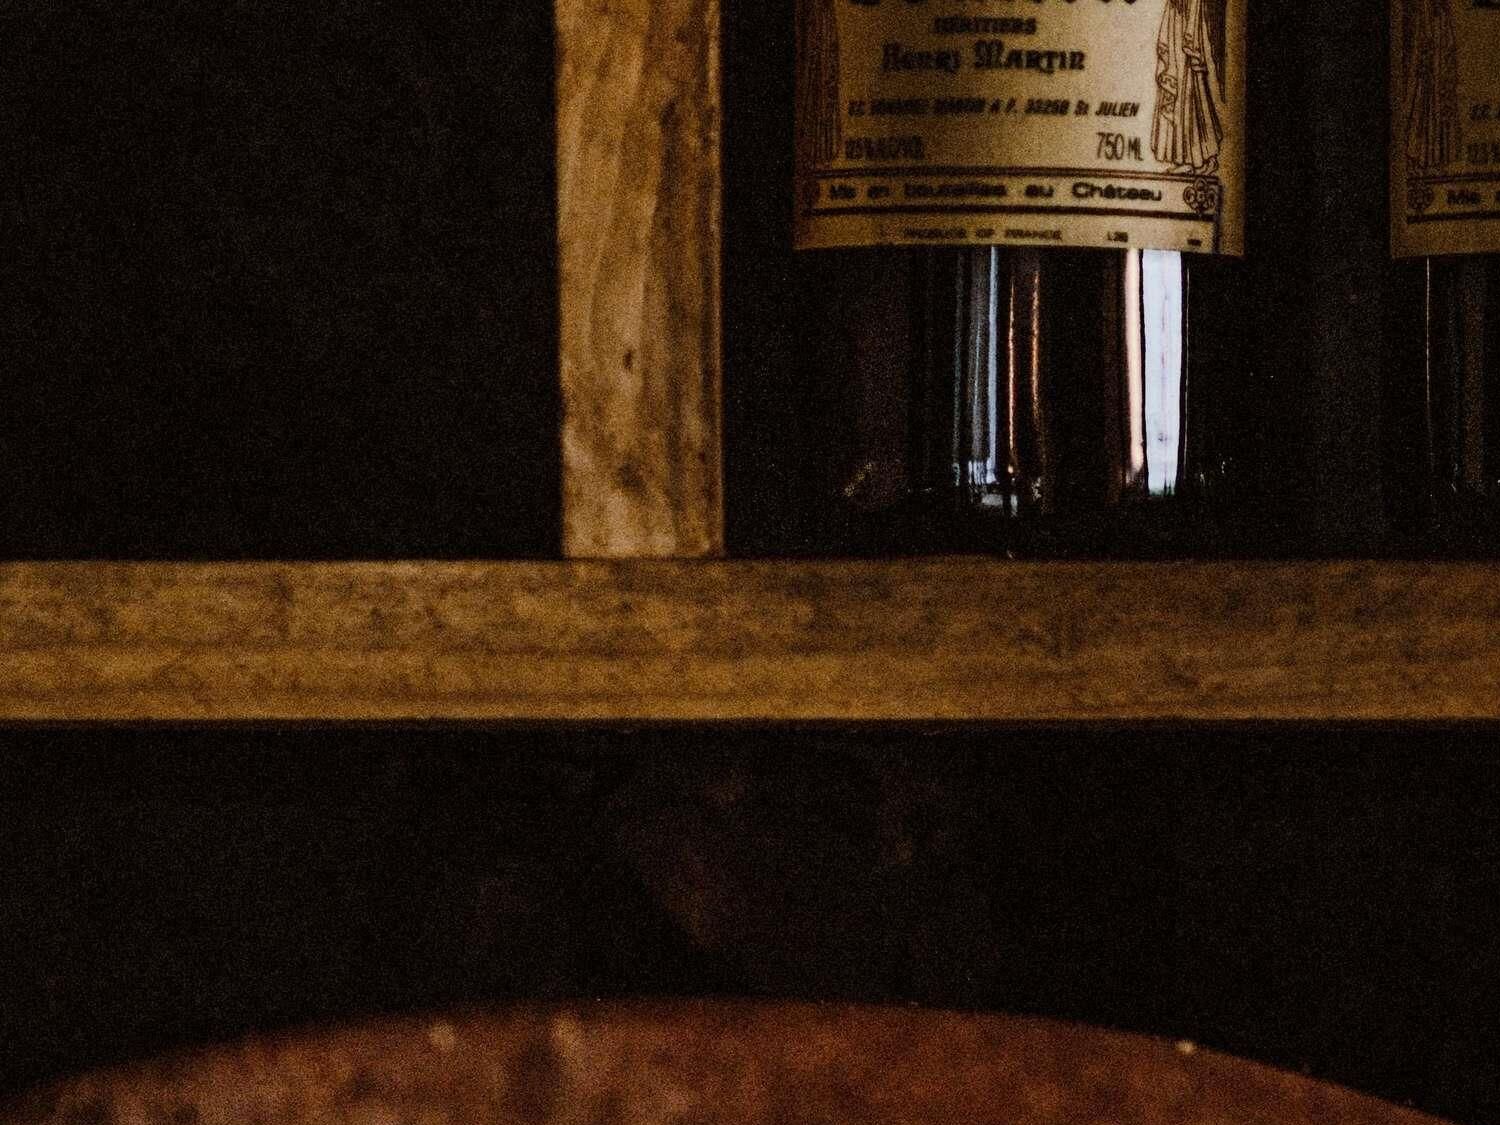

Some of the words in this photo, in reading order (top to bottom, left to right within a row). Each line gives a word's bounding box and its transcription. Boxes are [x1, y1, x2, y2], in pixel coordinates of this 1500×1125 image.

[1094, 101, 1142, 118] JULIEN
[1096, 131, 1126, 162] 750
[1024, 184, 1055, 199] au
[1071, 182, 1163, 202] Château
